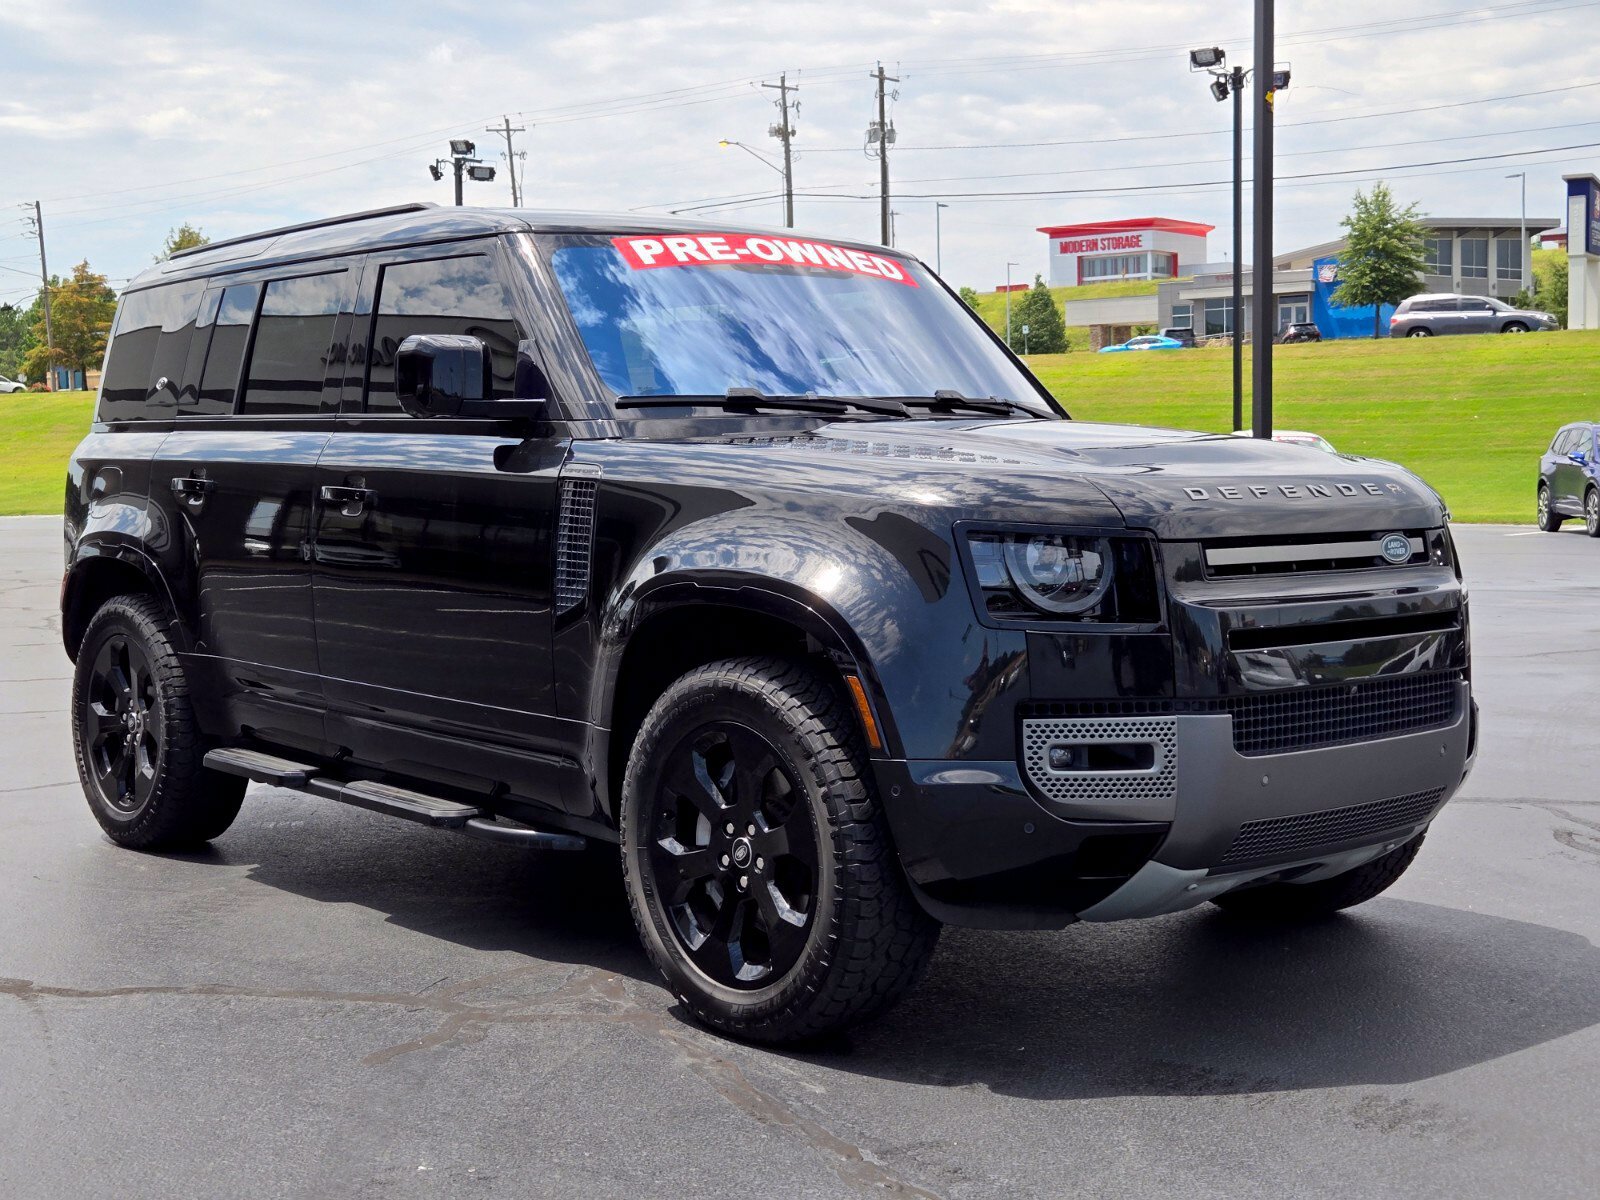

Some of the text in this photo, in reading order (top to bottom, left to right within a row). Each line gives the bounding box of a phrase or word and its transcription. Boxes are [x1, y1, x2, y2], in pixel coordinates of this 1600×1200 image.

[1059, 235, 1142, 254] MODERN STORAGE
[628, 236, 904, 281] PRE-OWNED
[1182, 482, 1406, 501] DEFENDER
